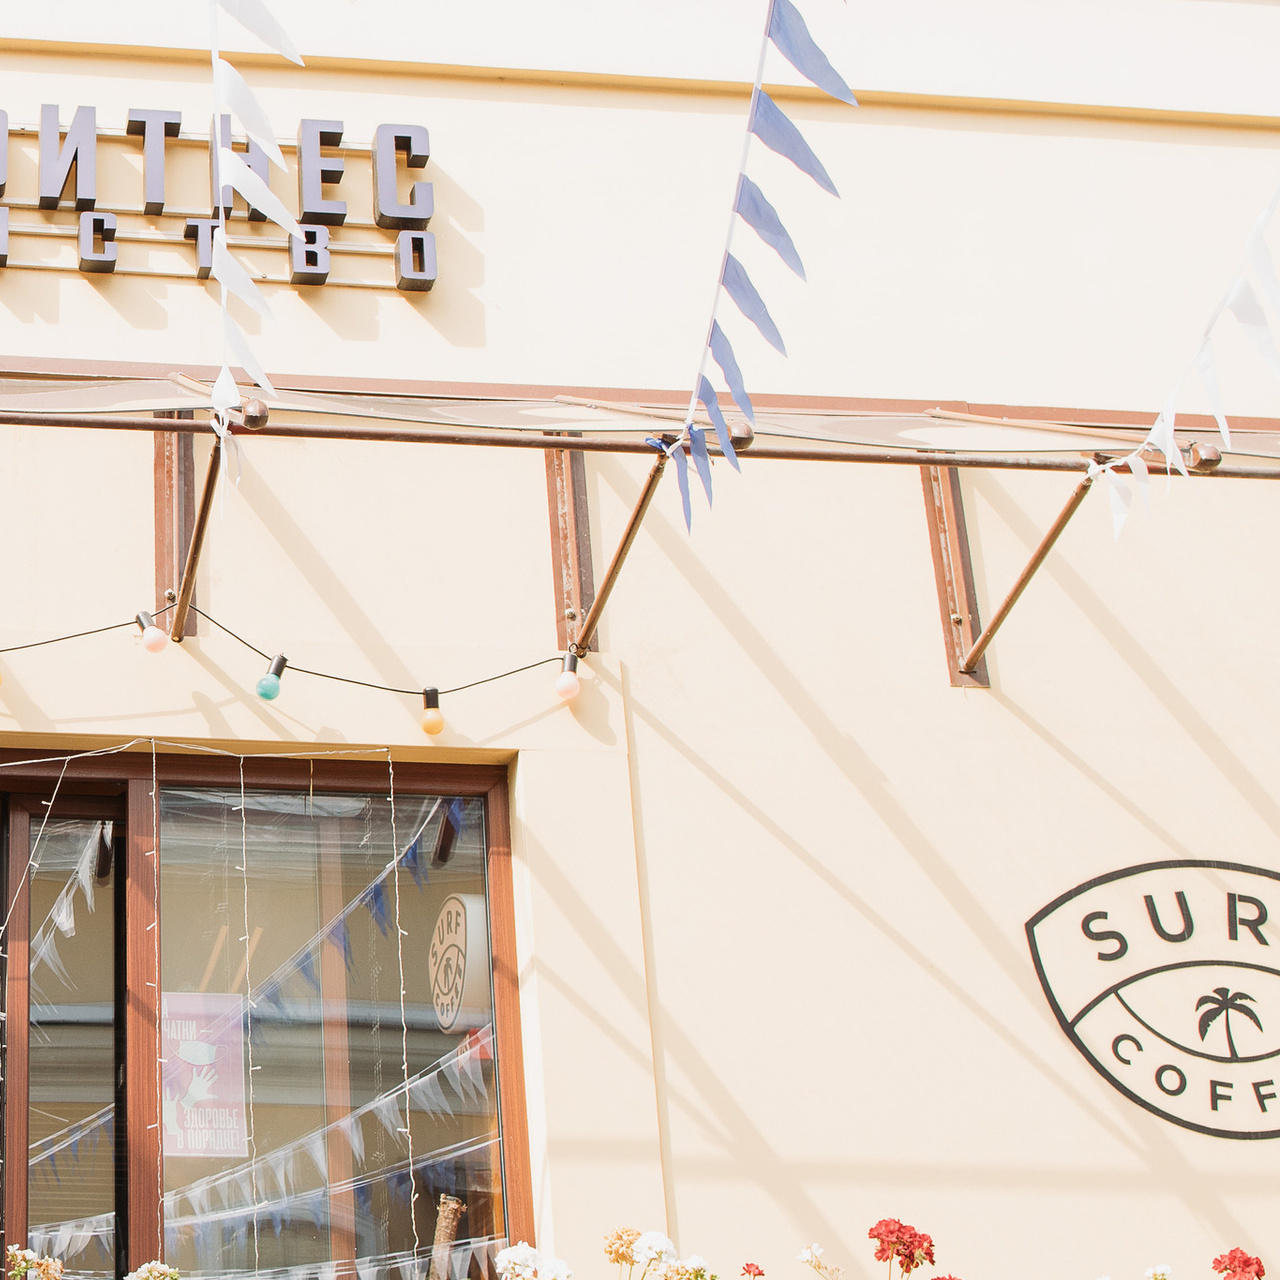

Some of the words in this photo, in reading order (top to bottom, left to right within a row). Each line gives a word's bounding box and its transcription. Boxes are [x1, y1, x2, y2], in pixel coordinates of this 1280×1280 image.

[431, 910, 462, 967] SURF
[1081, 890, 1270, 962] SUR
[163, 1020, 197, 1040] ЧАТКИ
[1111, 1033, 1278, 1113] COFF
[183, 1107, 239, 1129] ЗДОРОВЬЕ
[177, 1129, 184, 1149] В
